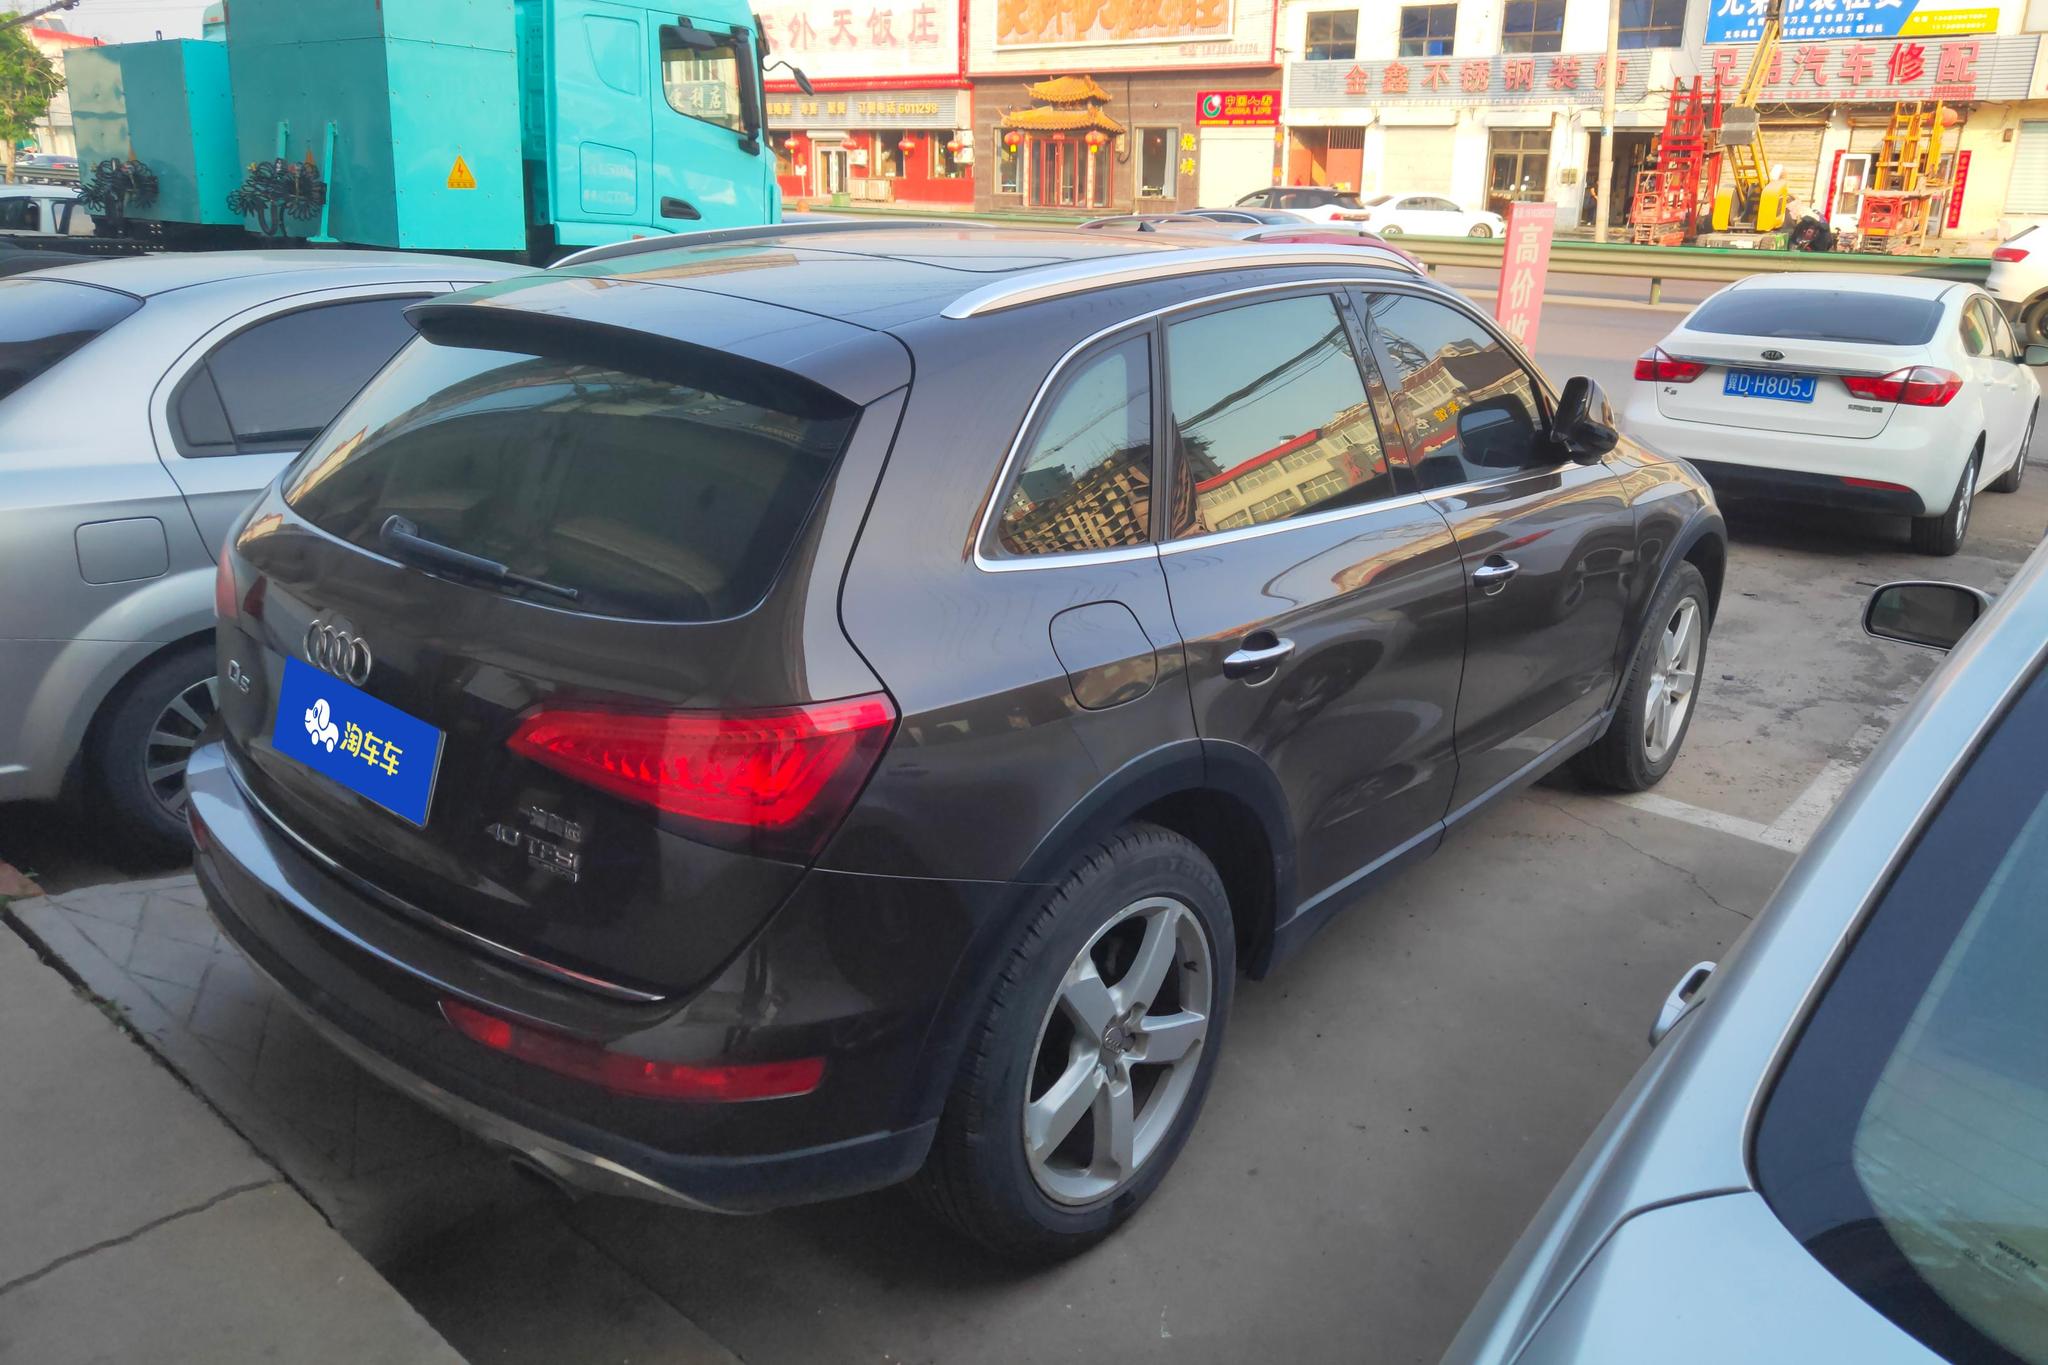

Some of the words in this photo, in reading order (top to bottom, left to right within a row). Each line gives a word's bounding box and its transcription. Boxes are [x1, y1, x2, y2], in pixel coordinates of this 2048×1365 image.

[1344, 55, 1629, 94] 金鑫不锈钢装饰
[1225, 95, 1273, 107] 中国人寿
